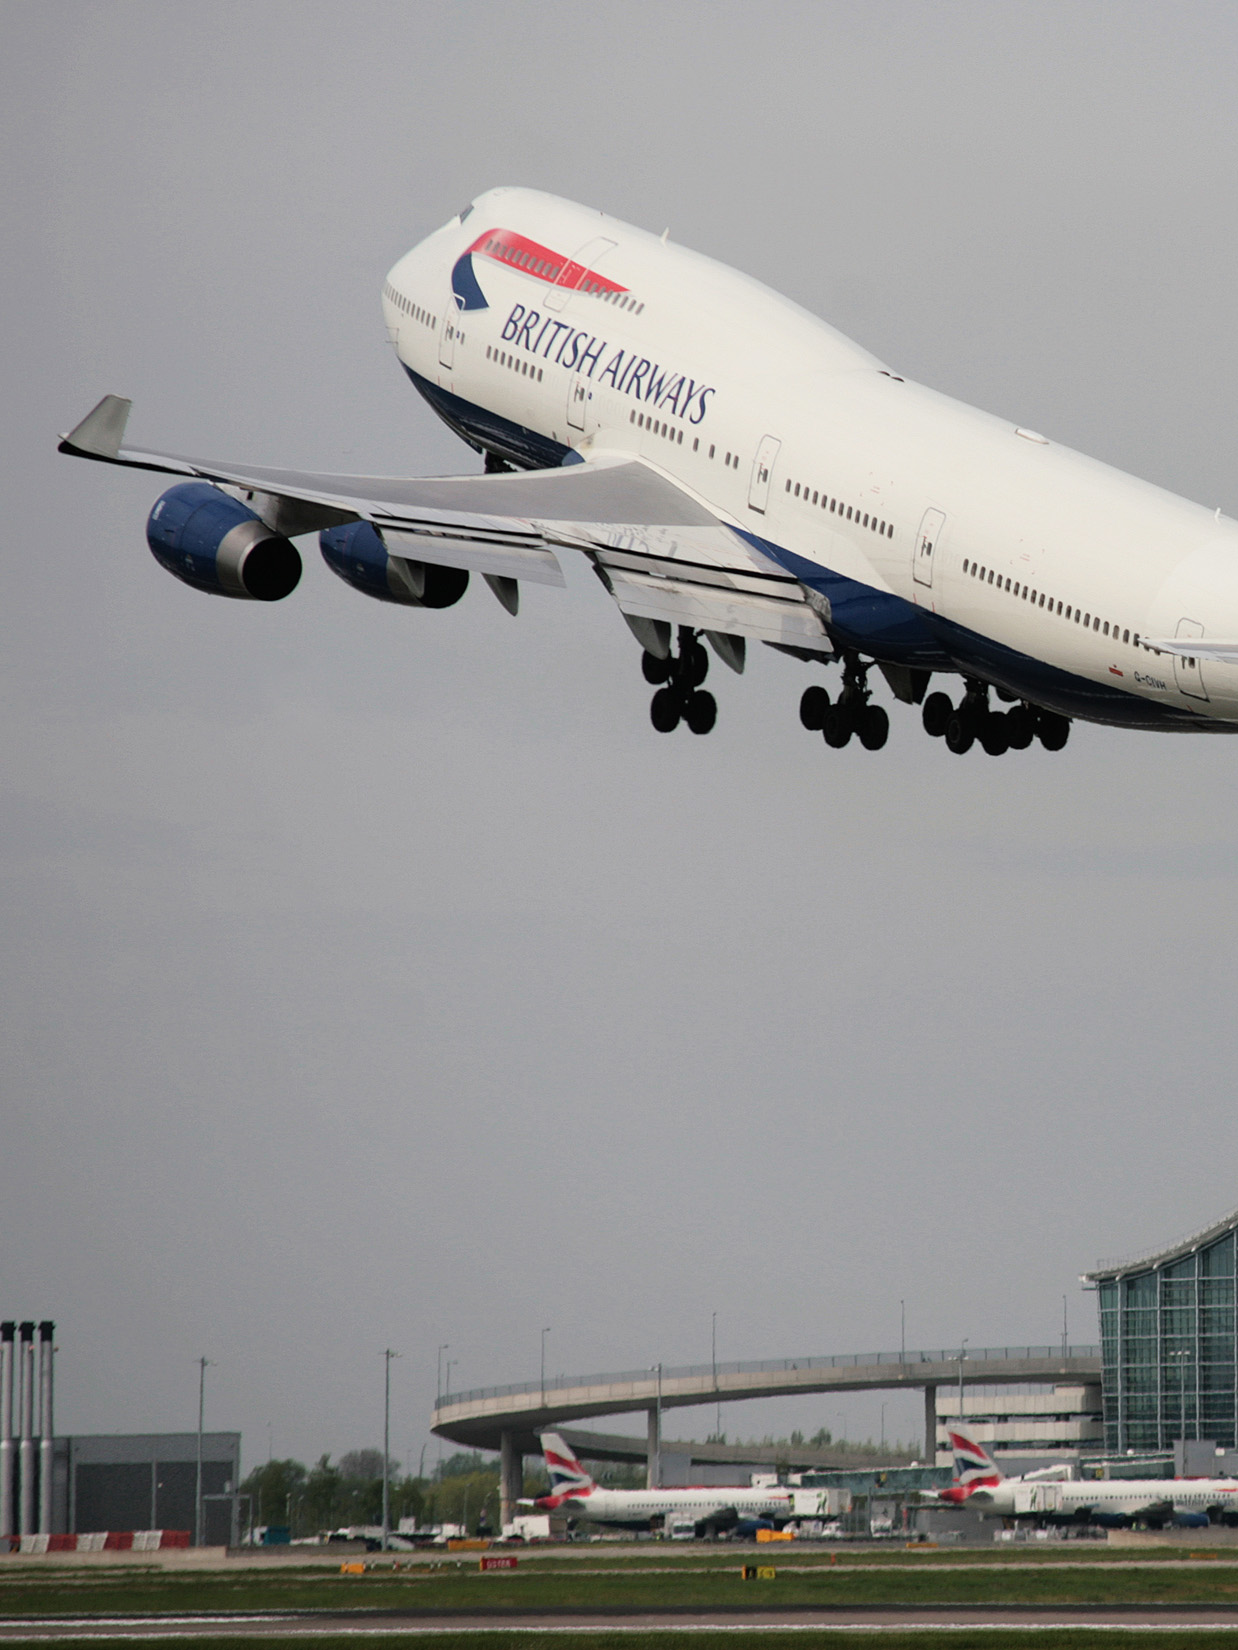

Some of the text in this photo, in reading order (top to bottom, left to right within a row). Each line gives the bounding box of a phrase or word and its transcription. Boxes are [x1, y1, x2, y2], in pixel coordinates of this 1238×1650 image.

[501, 303, 716, 425] BRITISH AIRWAYS
[1134, 671, 1168, 690] G-CIVH
